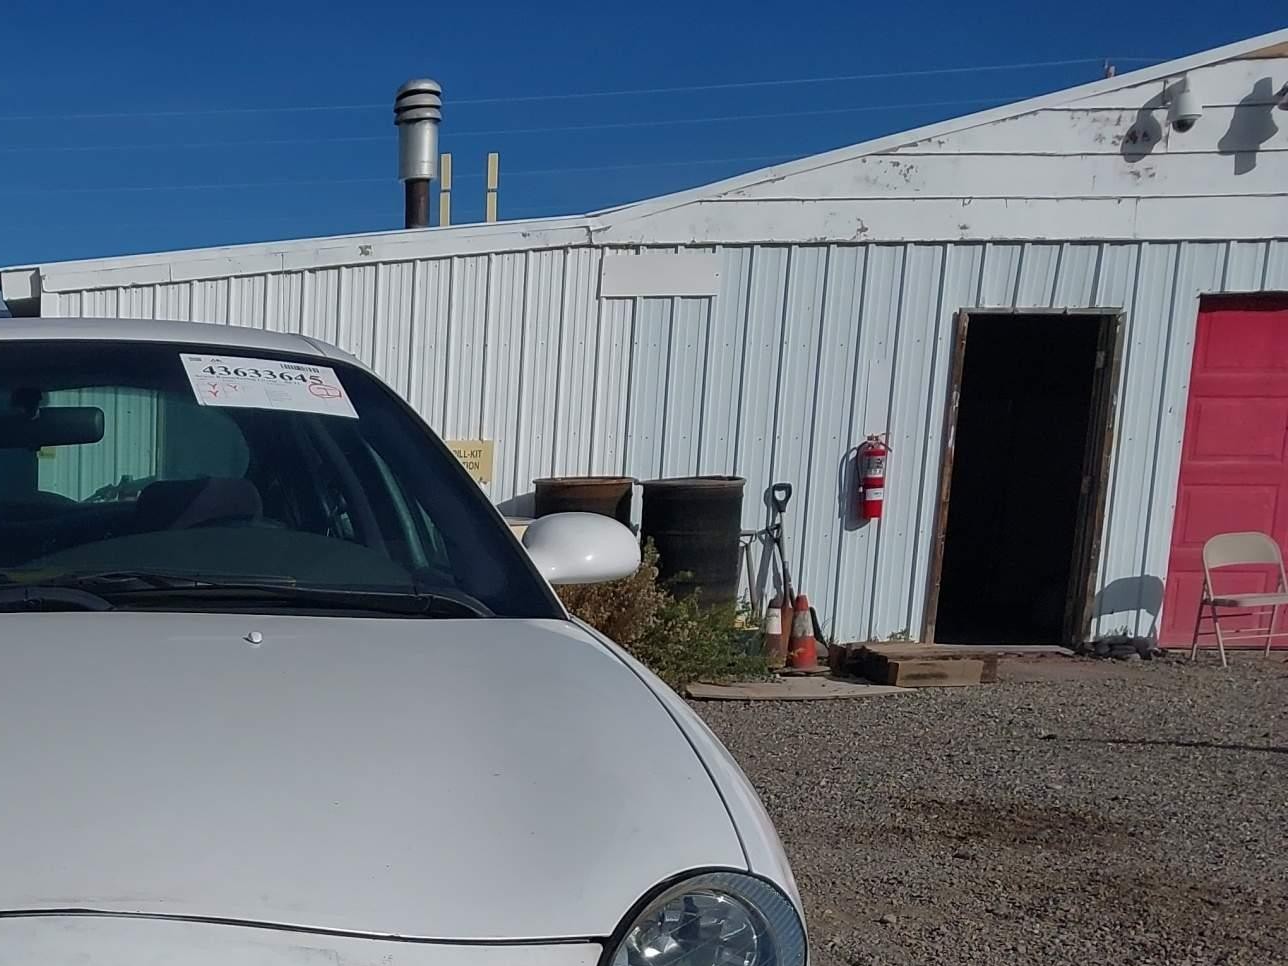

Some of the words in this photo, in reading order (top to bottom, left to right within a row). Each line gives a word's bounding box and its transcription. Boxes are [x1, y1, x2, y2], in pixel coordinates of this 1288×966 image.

[202, 365, 323, 385] 43633645
[453, 449, 482, 459] PILL-KIT
[462, 461, 480, 471] TION
